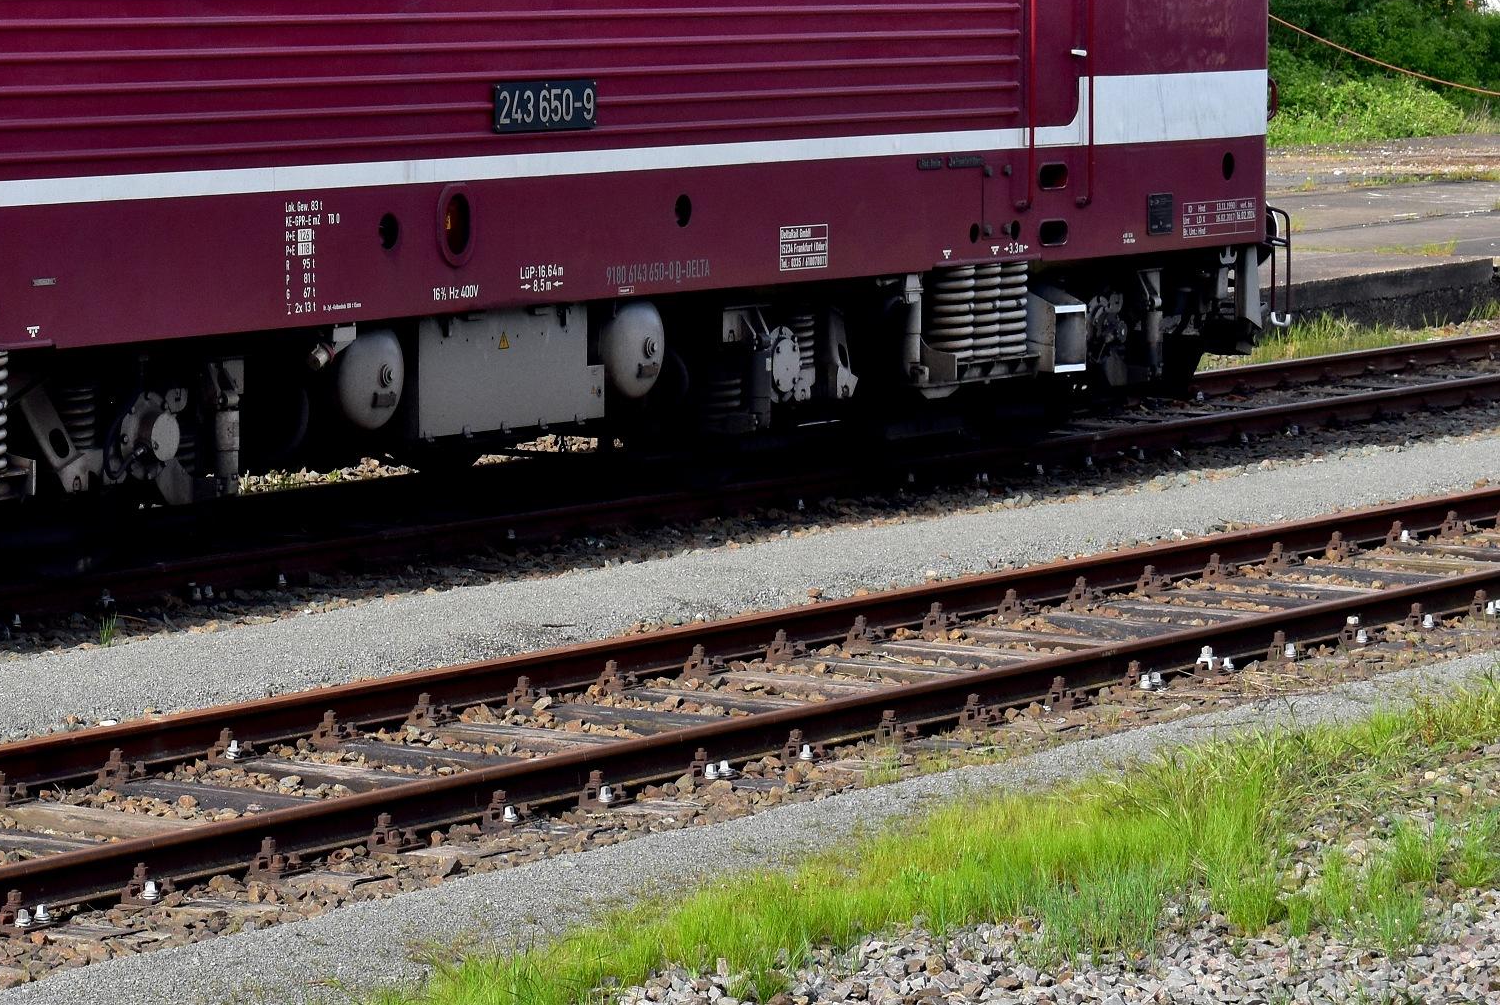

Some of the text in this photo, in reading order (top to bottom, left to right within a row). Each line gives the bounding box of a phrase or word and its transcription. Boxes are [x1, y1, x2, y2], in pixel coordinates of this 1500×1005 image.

[499, 88, 594, 124] 243 650-9
[285, 230, 296, 242] R+E
[285, 244, 296, 256] P+E
[794, 242, 813, 253] Frankfurt
[302, 258, 311, 269] 95
[303, 272, 311, 284] 81
[303, 286, 311, 298] 67
[449, 287, 460, 299] Hz
[460, 284, 479, 298] 400V
[304, 301, 312, 313] 13
